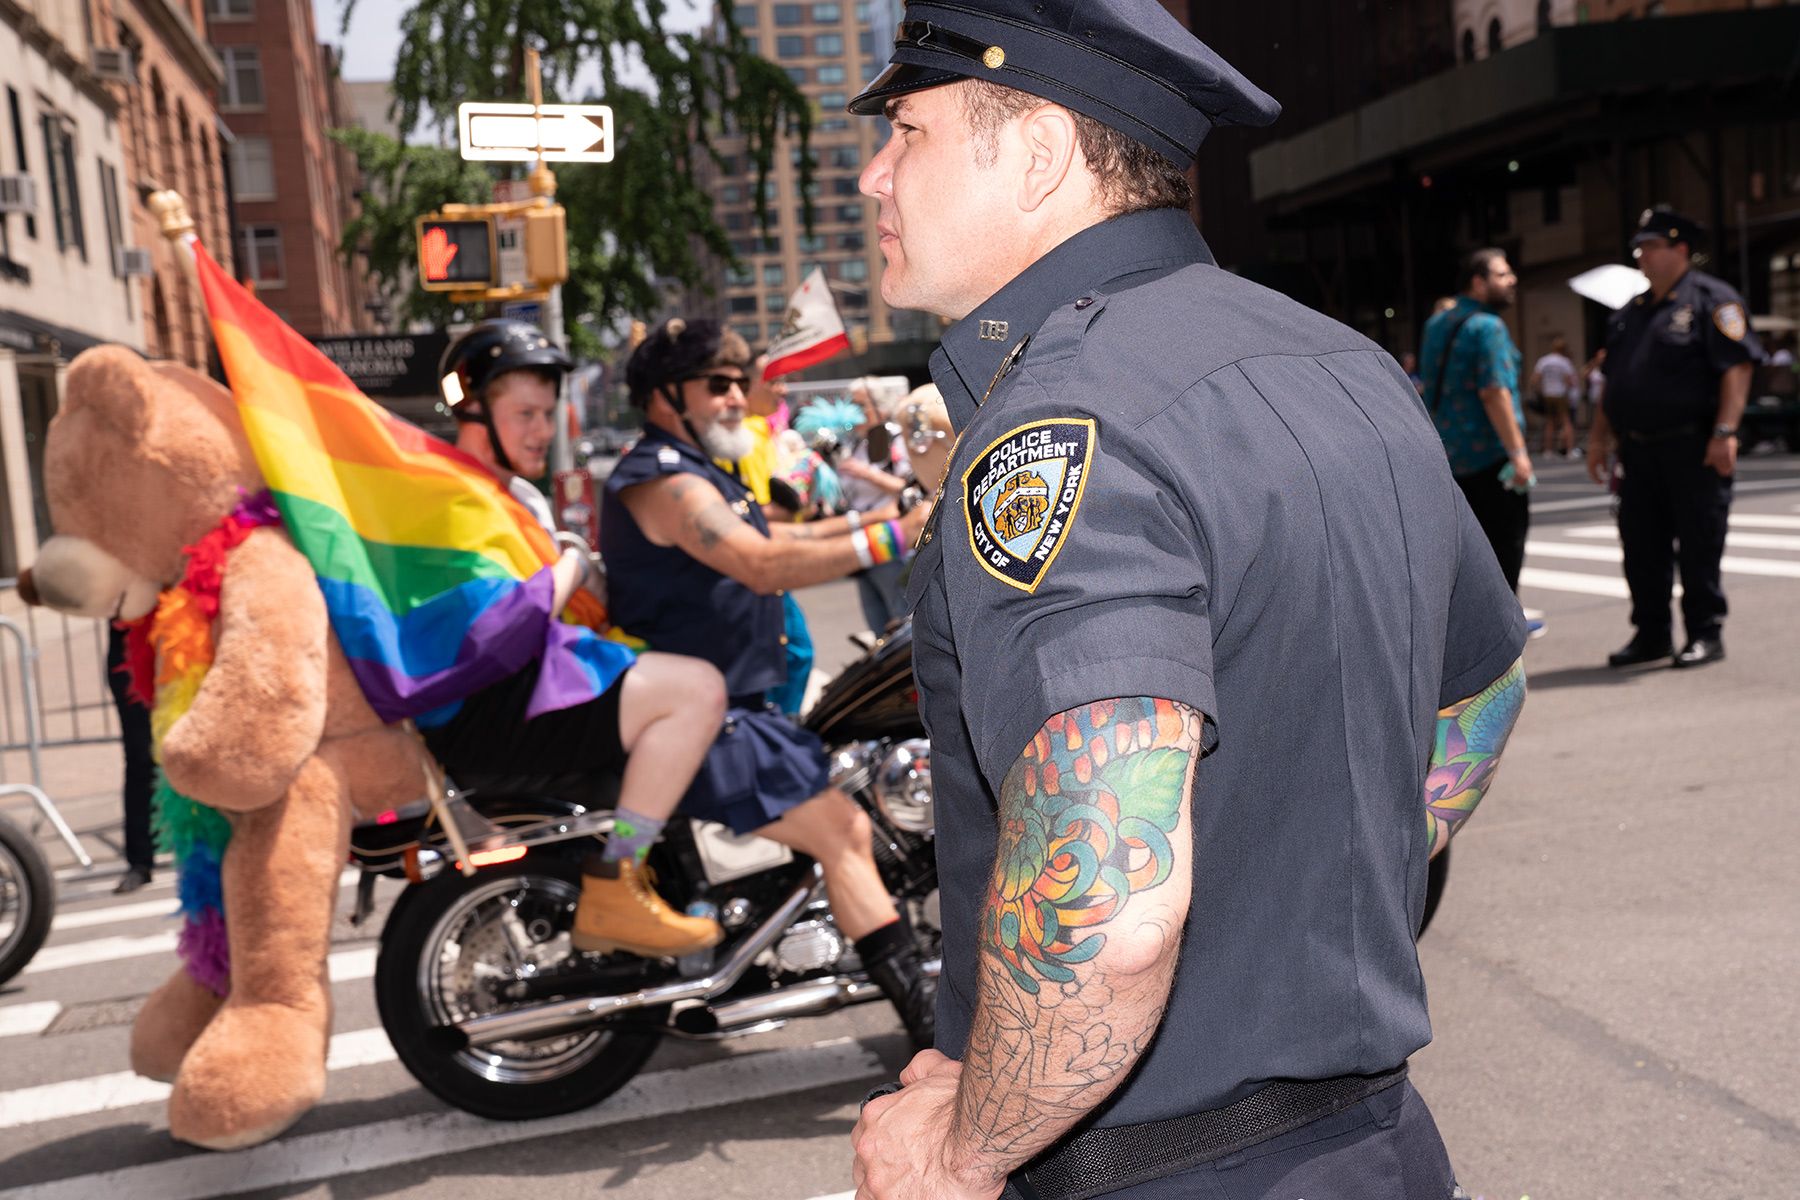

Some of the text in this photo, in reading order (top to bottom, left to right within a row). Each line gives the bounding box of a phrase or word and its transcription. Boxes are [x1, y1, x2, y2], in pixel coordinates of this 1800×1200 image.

[337, 358, 408, 376] ONOMA
[989, 430, 1052, 469] POLICE
[973, 442, 1078, 506] DEPARTMENT
[1035, 463, 1083, 561] NEW YORK
[974, 521, 1010, 568] CITY OF
